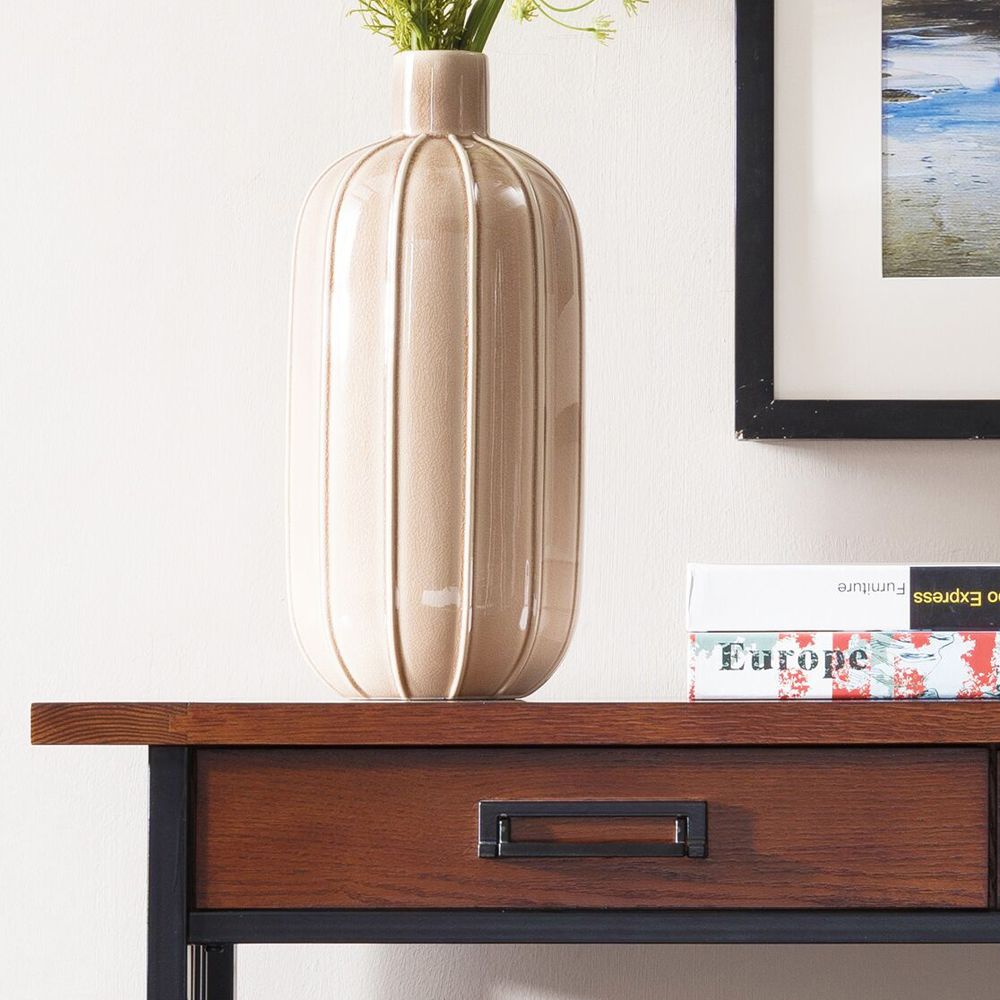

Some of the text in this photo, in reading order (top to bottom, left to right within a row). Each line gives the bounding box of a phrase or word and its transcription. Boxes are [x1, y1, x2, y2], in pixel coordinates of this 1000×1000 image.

[837, 582, 906, 596] Furniture
[914, 588, 983, 607] Express
[719, 642, 868, 679] Europe
